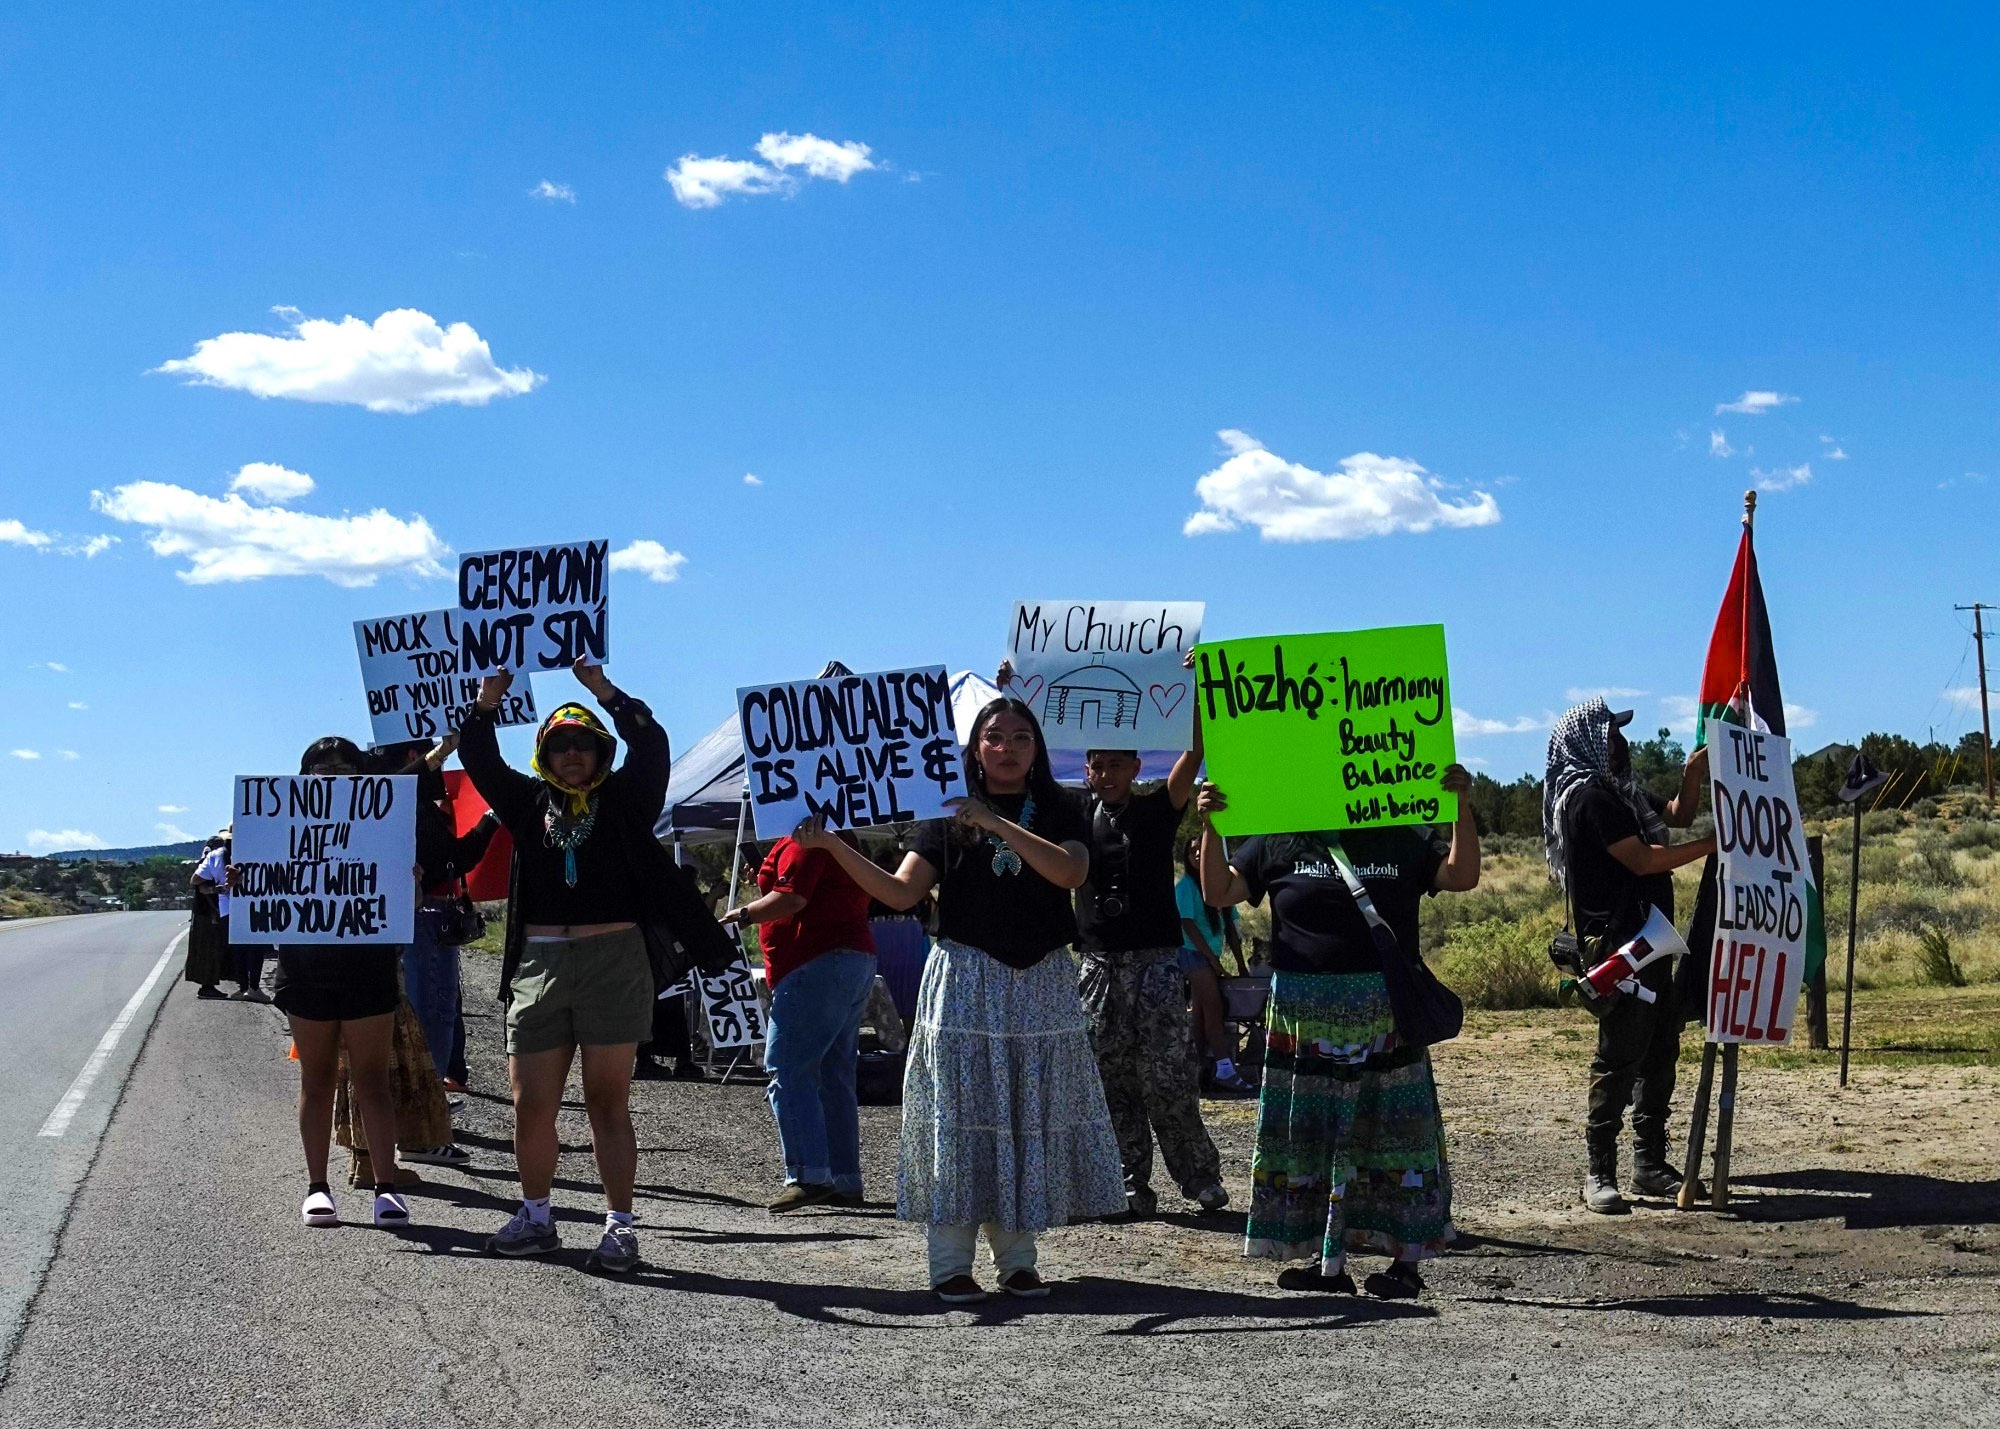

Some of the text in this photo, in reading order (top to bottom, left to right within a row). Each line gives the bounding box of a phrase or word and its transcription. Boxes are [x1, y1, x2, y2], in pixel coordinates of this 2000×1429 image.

[459, 540, 608, 613] CEREMONY,
[363, 615, 432, 657] MOCK
[462, 613, 534, 673] NOT
[538, 610, 606, 668] SIN
[1065, 606, 1183, 655] Church
[368, 685, 399, 716] BUT
[405, 691, 535, 738] US FOER!
[743, 669, 955, 758] COLONIALISM
[1341, 656, 1444, 726] harmony
[1339, 718, 1415, 761] Beauty
[1729, 729, 1769, 782] THE
[752, 736, 958, 804] IS ALIVE &
[1342, 759, 1437, 791] Balance
[241, 776, 393, 820] IT'S NOT TOO
[805, 777, 914, 829] WELL
[1346, 792, 1440, 825] Well-being
[1714, 779, 1800, 871] DOOR
[233, 860, 377, 897] RECONNECT WITH
[1718, 862, 1803, 942] LEADS TO
[250, 894, 388, 938] WHO YOU ARE!
[1709, 938, 1788, 1041] HELL
